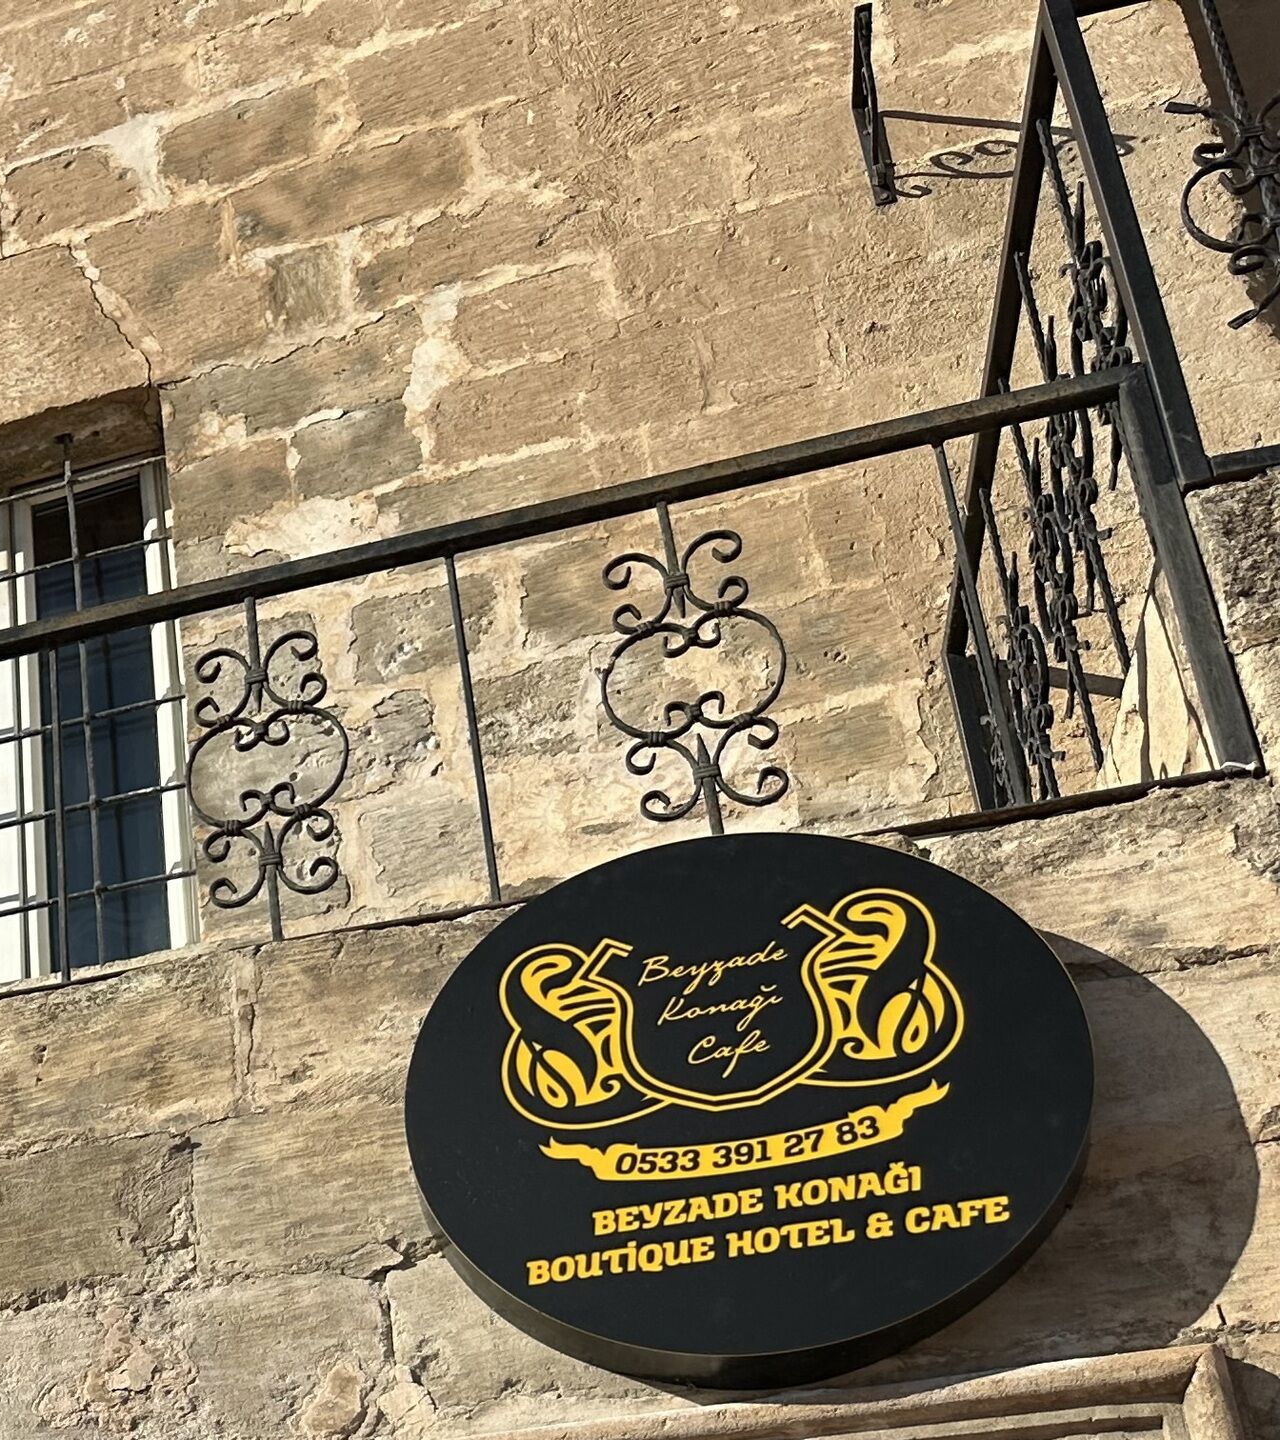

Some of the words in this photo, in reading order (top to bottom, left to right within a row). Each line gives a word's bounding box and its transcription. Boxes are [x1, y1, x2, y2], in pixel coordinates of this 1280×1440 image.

[638, 940, 788, 996] Beyzade
[656, 983, 784, 1032] Konağı
[687, 1029, 772, 1079] Cafe
[614, 1149, 701, 1175] 0533
[711, 1138, 773, 1170] 391
[783, 1128, 825, 1159] 27
[837, 1114, 882, 1146] 83
[591, 1187, 764, 1236] BEYZADE
[773, 1161, 922, 1210] KONAĞI
[526, 1234, 716, 1286] BOUTİQUE
[725, 1217, 855, 1260] HOTEL
[865, 1210, 895, 1240] &
[904, 1195, 1011, 1236] CAFE
